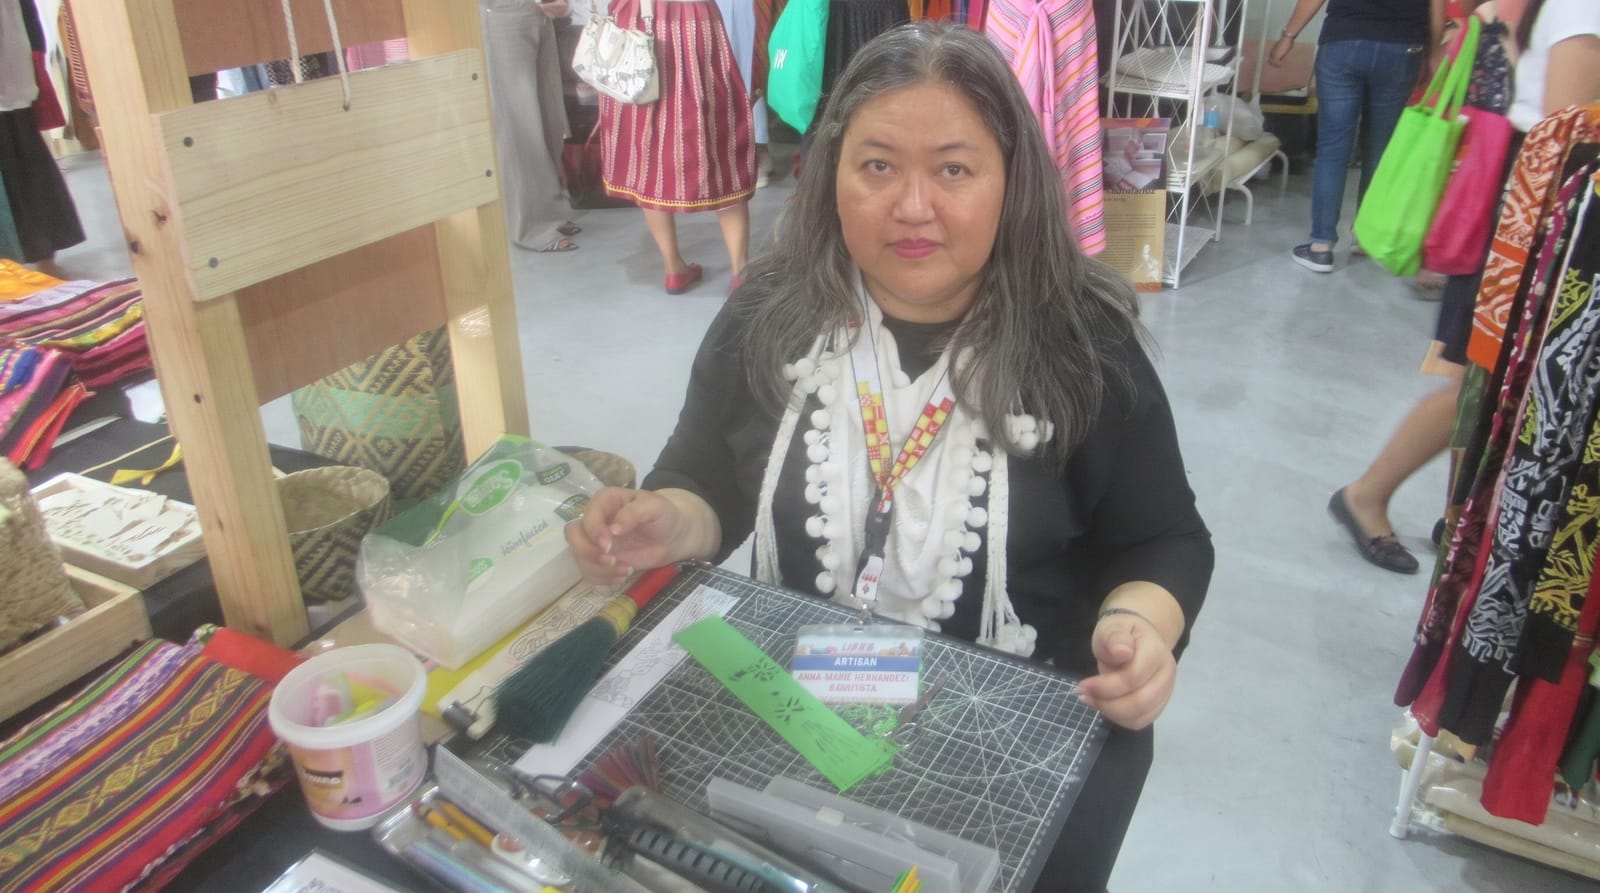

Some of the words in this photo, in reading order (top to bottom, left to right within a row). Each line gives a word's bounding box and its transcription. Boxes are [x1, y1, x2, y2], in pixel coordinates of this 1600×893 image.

[834, 657, 878, 667] ARTISAN
[798, 672, 822, 681] ANNA
[825, 672, 851, 681] MARIE
